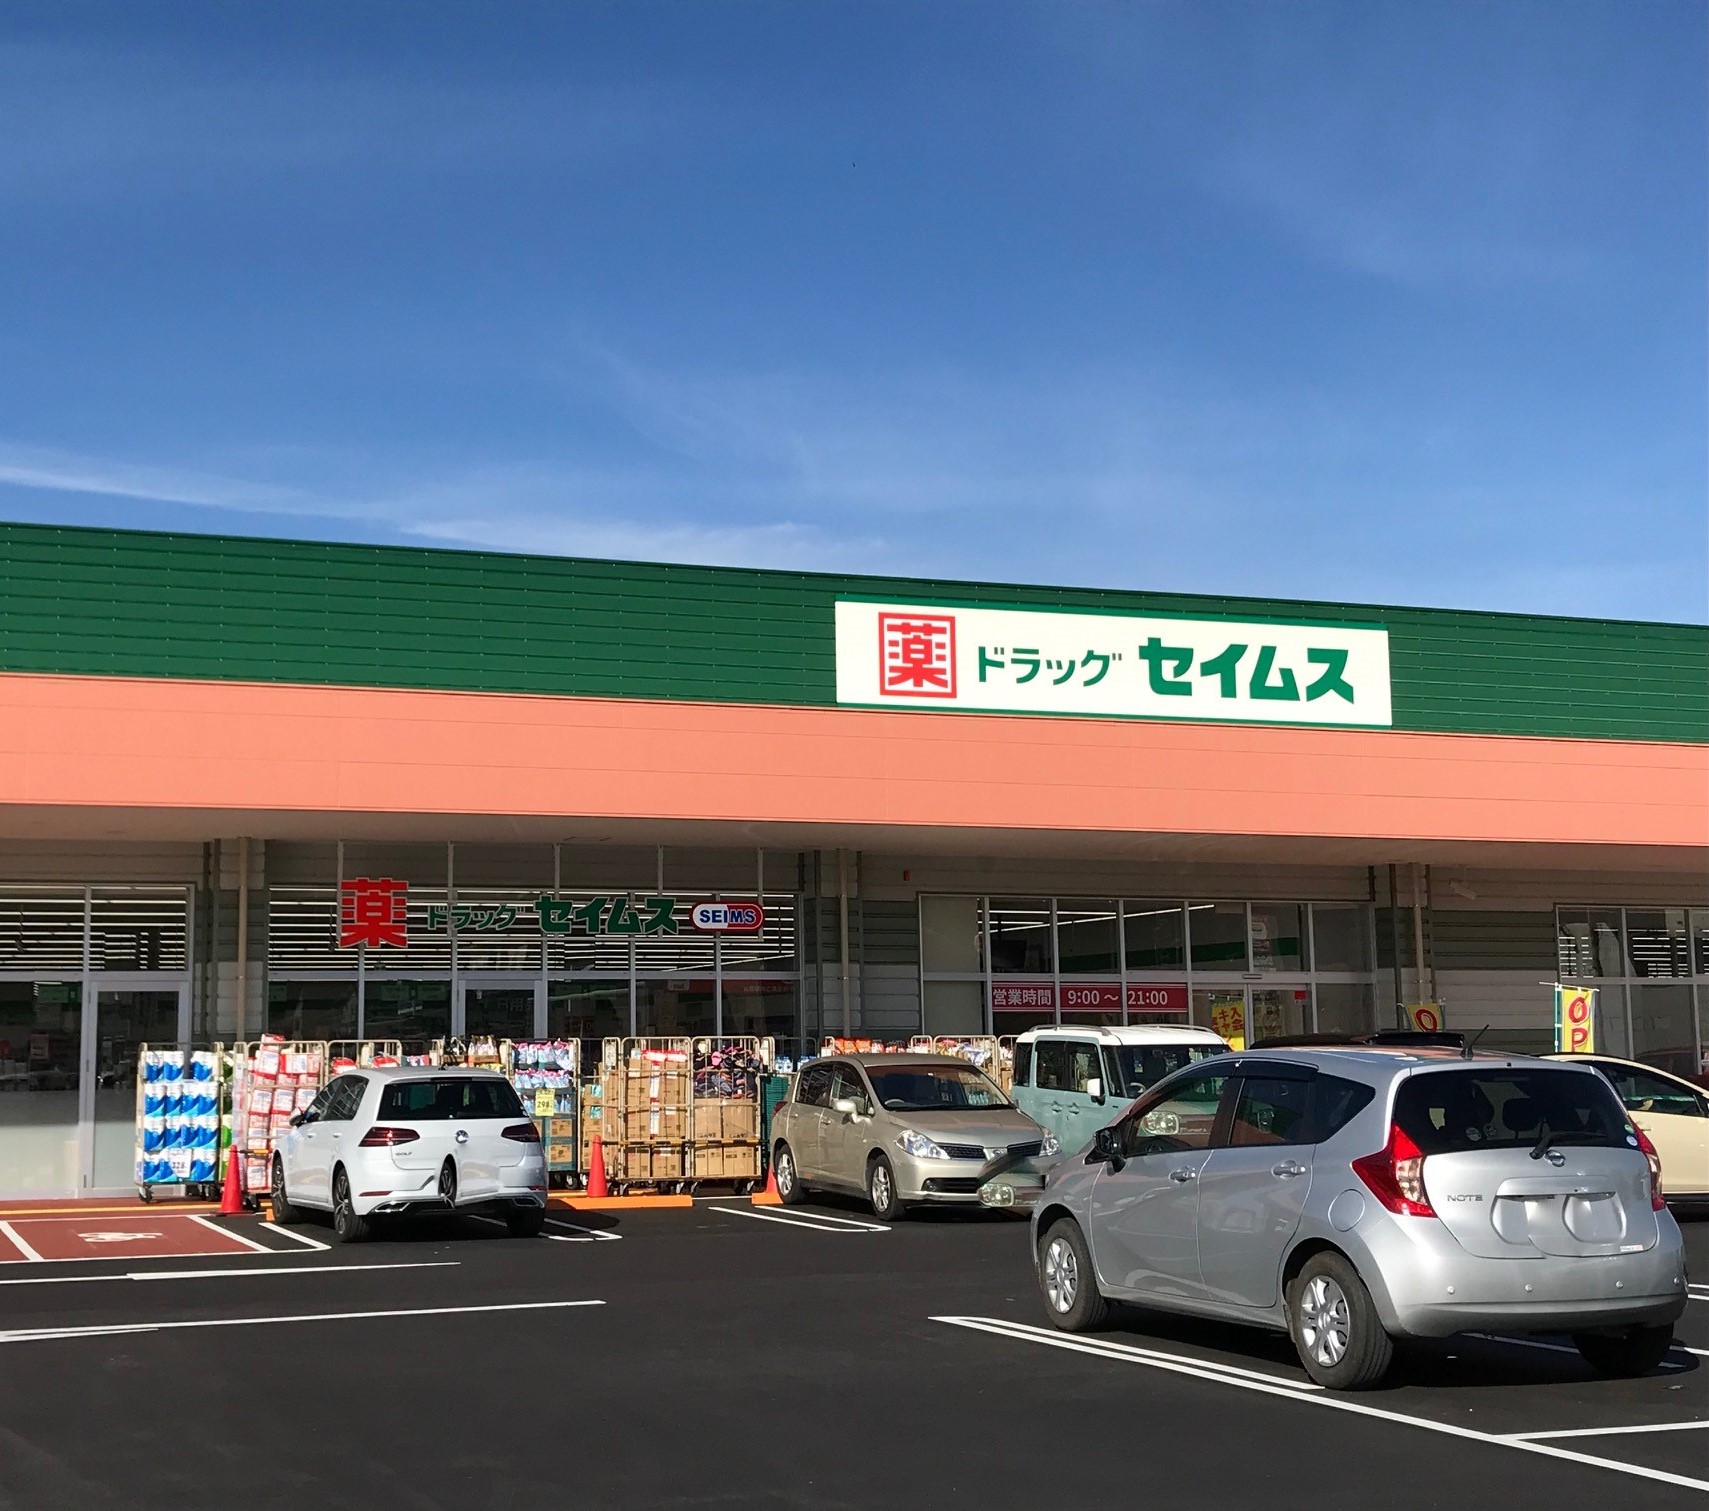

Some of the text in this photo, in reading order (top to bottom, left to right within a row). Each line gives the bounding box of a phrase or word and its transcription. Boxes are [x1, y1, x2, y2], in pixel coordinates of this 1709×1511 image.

[886, 621, 1355, 705] 薬 ドラッグ セイムス
[339, 877, 679, 948] 薬 ドラッグ セイムス
[699, 909, 757, 924] SEIMS
[992, 988, 1052, 1006] 営業時間
[1067, 989, 1100, 1005] 9:00
[1127, 990, 1168, 1006] 21:00
[1446, 1194, 1484, 1202] NOTE
